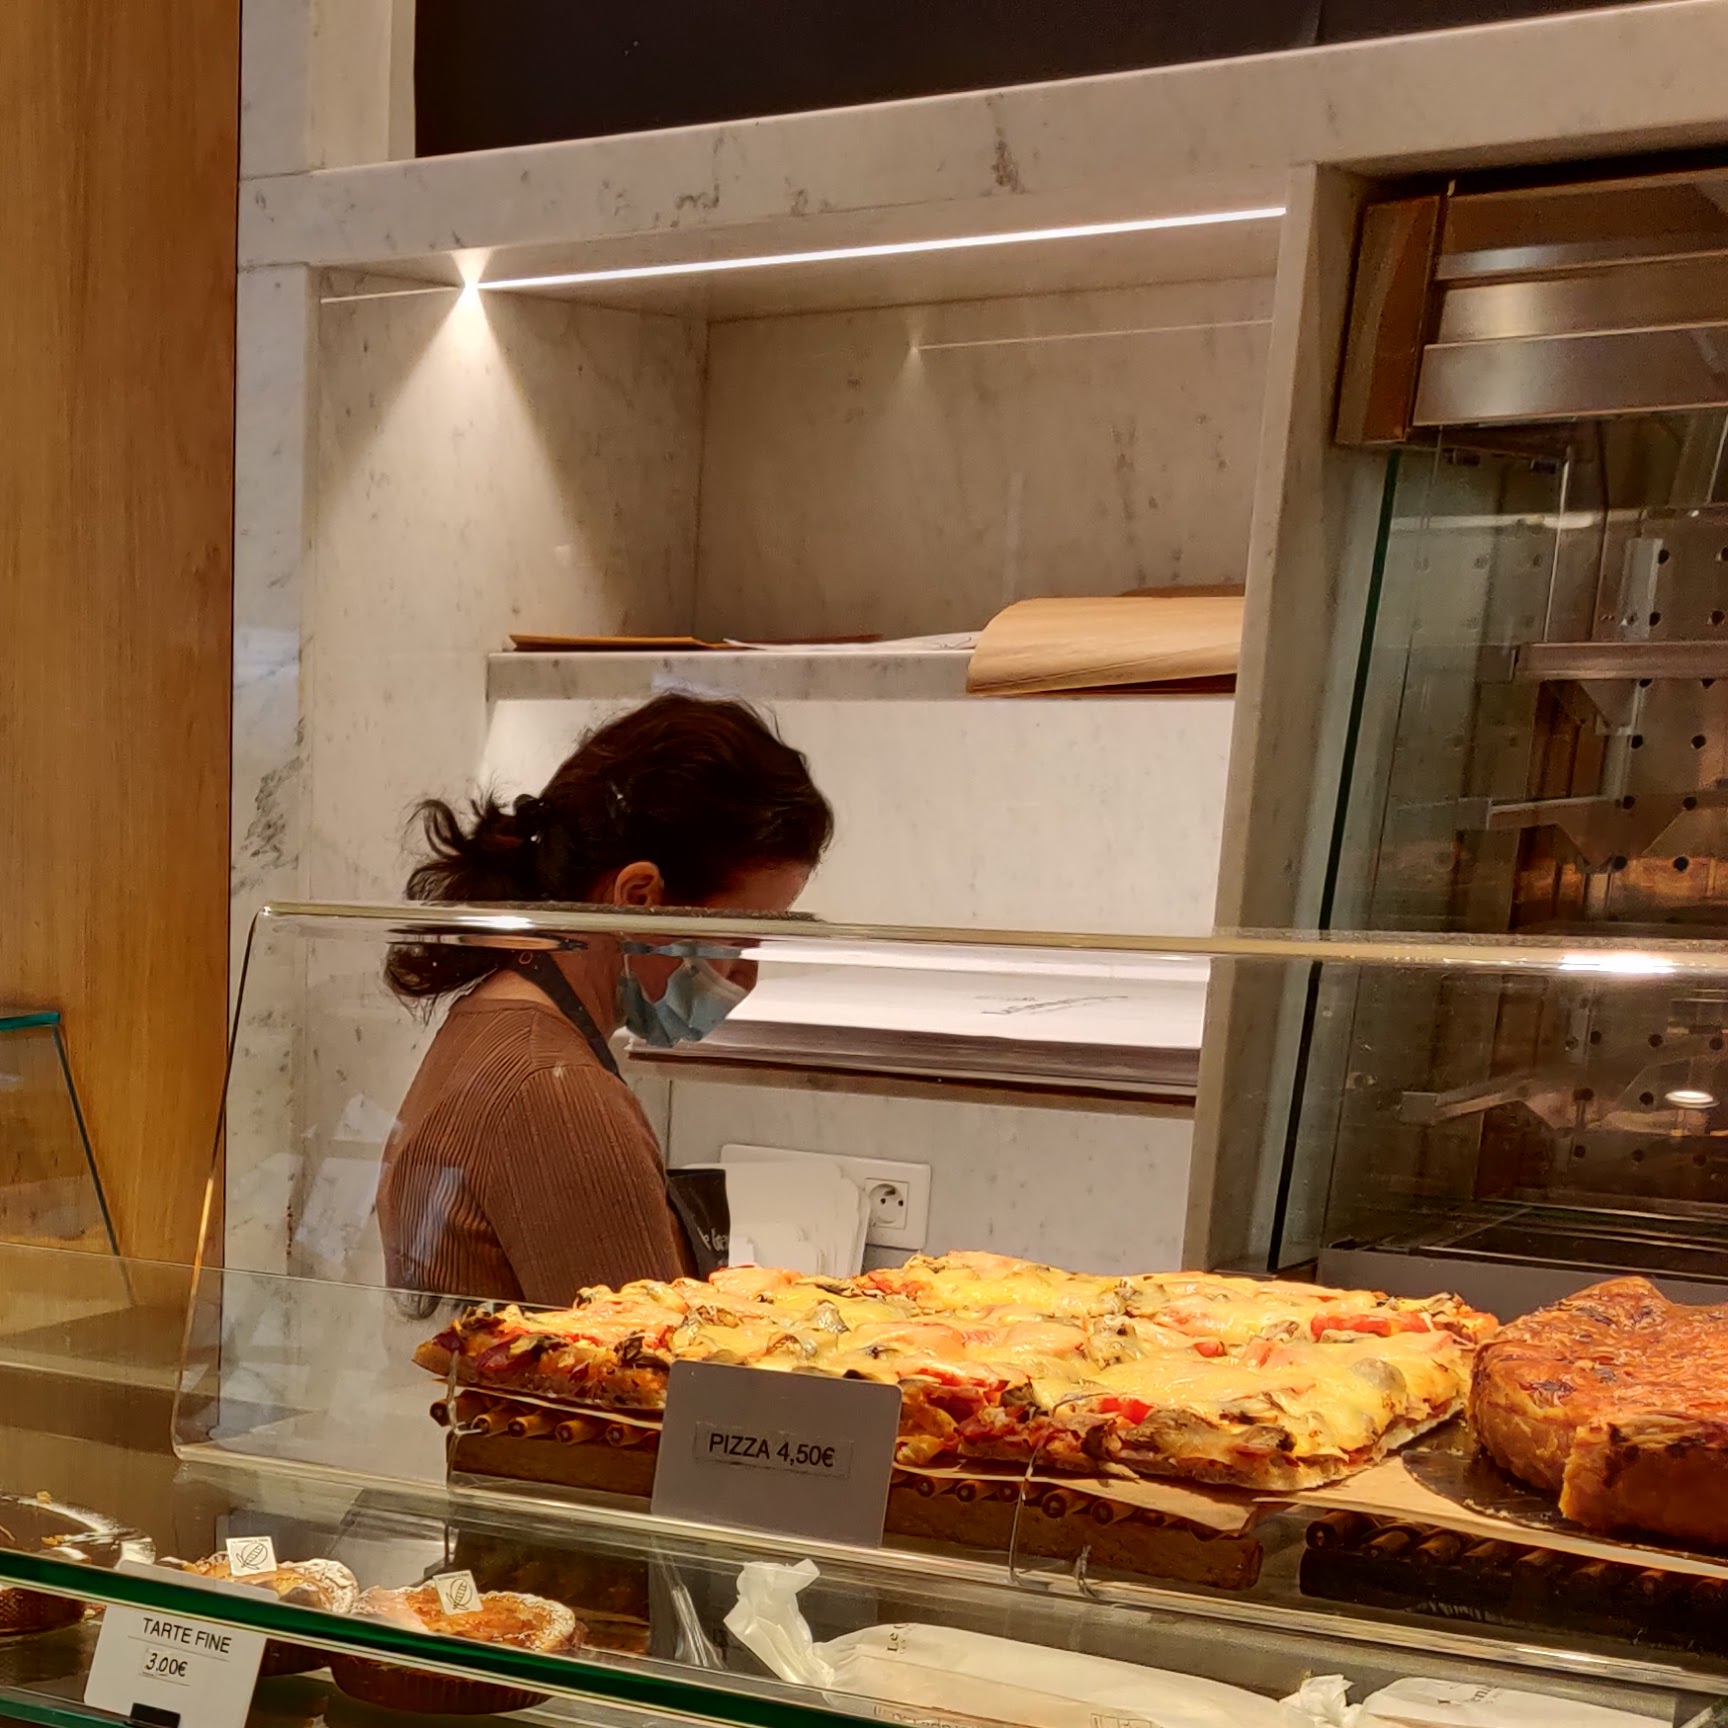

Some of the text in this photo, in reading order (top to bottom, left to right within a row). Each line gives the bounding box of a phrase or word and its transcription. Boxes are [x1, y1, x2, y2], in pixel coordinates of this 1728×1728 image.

[709, 1433, 835, 1468] PIZZA 4,50€
[142, 1617, 232, 1654] TARTE FINE
